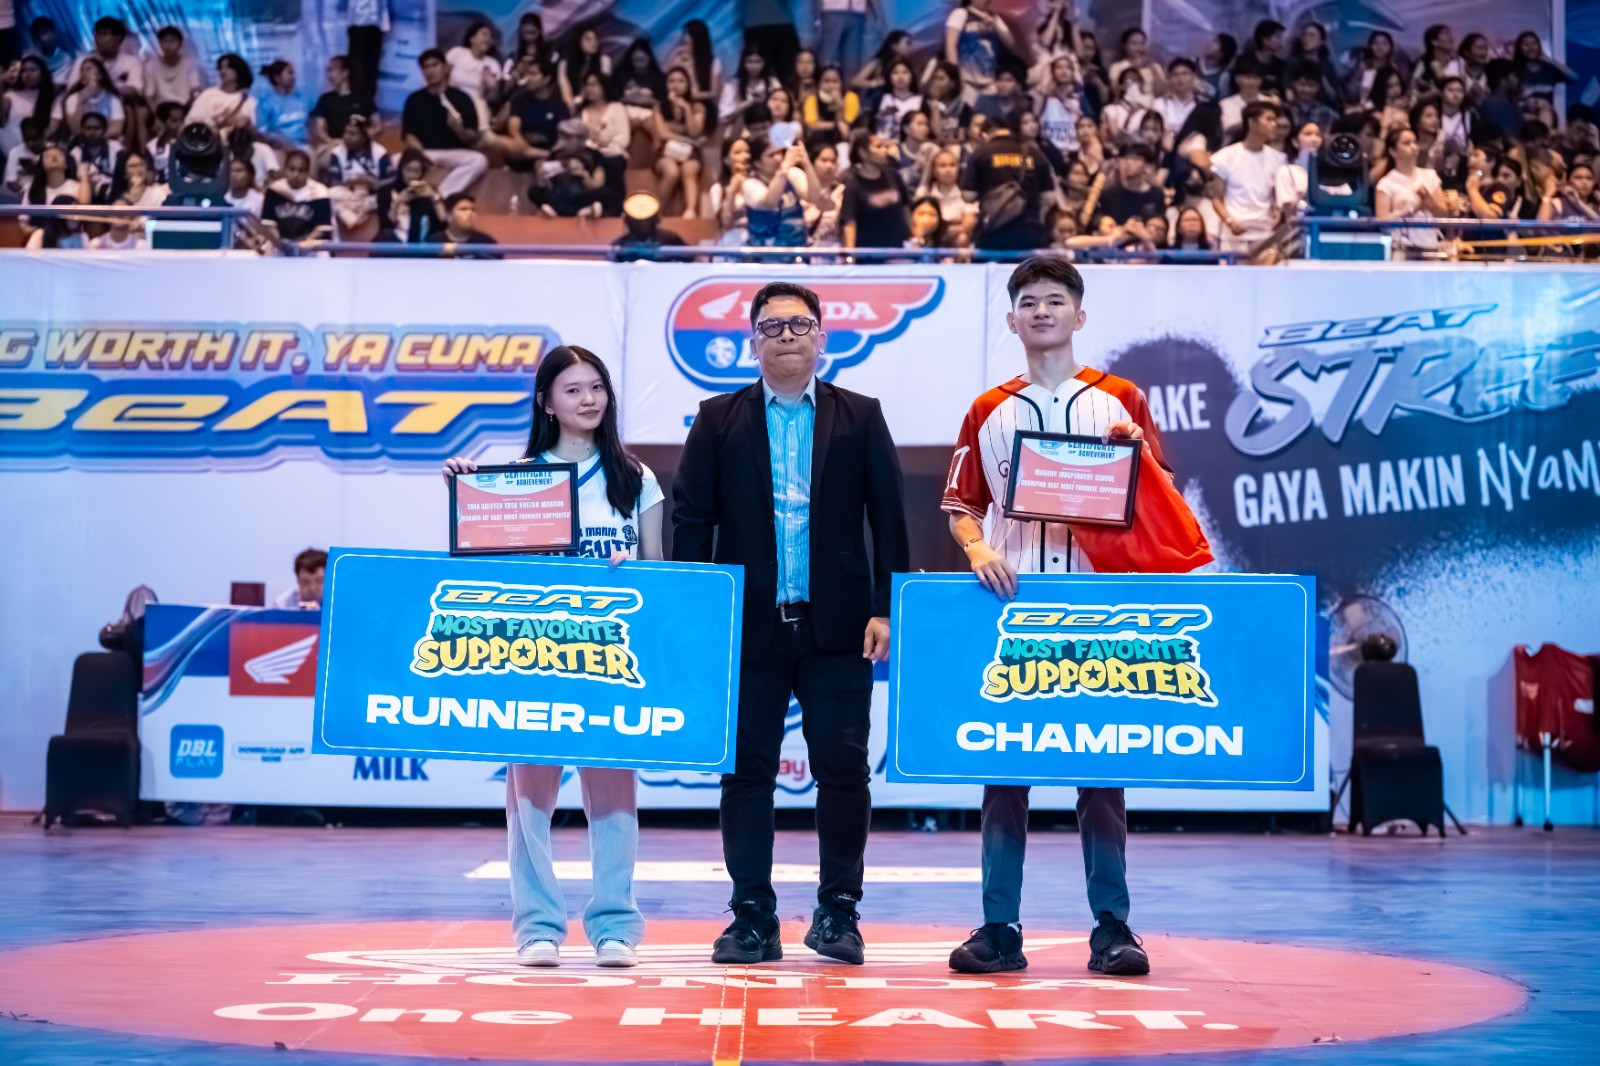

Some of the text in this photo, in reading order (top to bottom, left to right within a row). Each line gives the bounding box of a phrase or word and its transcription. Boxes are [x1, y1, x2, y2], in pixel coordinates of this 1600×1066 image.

[45, 329, 241, 369] WORTH
[322, 333, 393, 371] YA
[394, 334, 547, 372] CUMA
[1233, 467, 1328, 528] GAYA
[1339, 454, 1466, 518] MAKIN
[433, 614, 621, 643] MOST FAVORITE
[415, 637, 637, 681] SUPPORTER
[1000, 638, 1190, 661] MOST FAVORITE
[985, 659, 1207, 700] SUPPORTER
[366, 694, 685, 737] RUNNER-UP
[177, 739, 217, 757] DBL
[956, 721, 1243, 756] CHAMPION
[175, 757, 215, 768] PLAY
[352, 756, 430, 782] MILK
[265, 972, 1190, 992] HONDA
[212, 1002, 574, 1025] One
